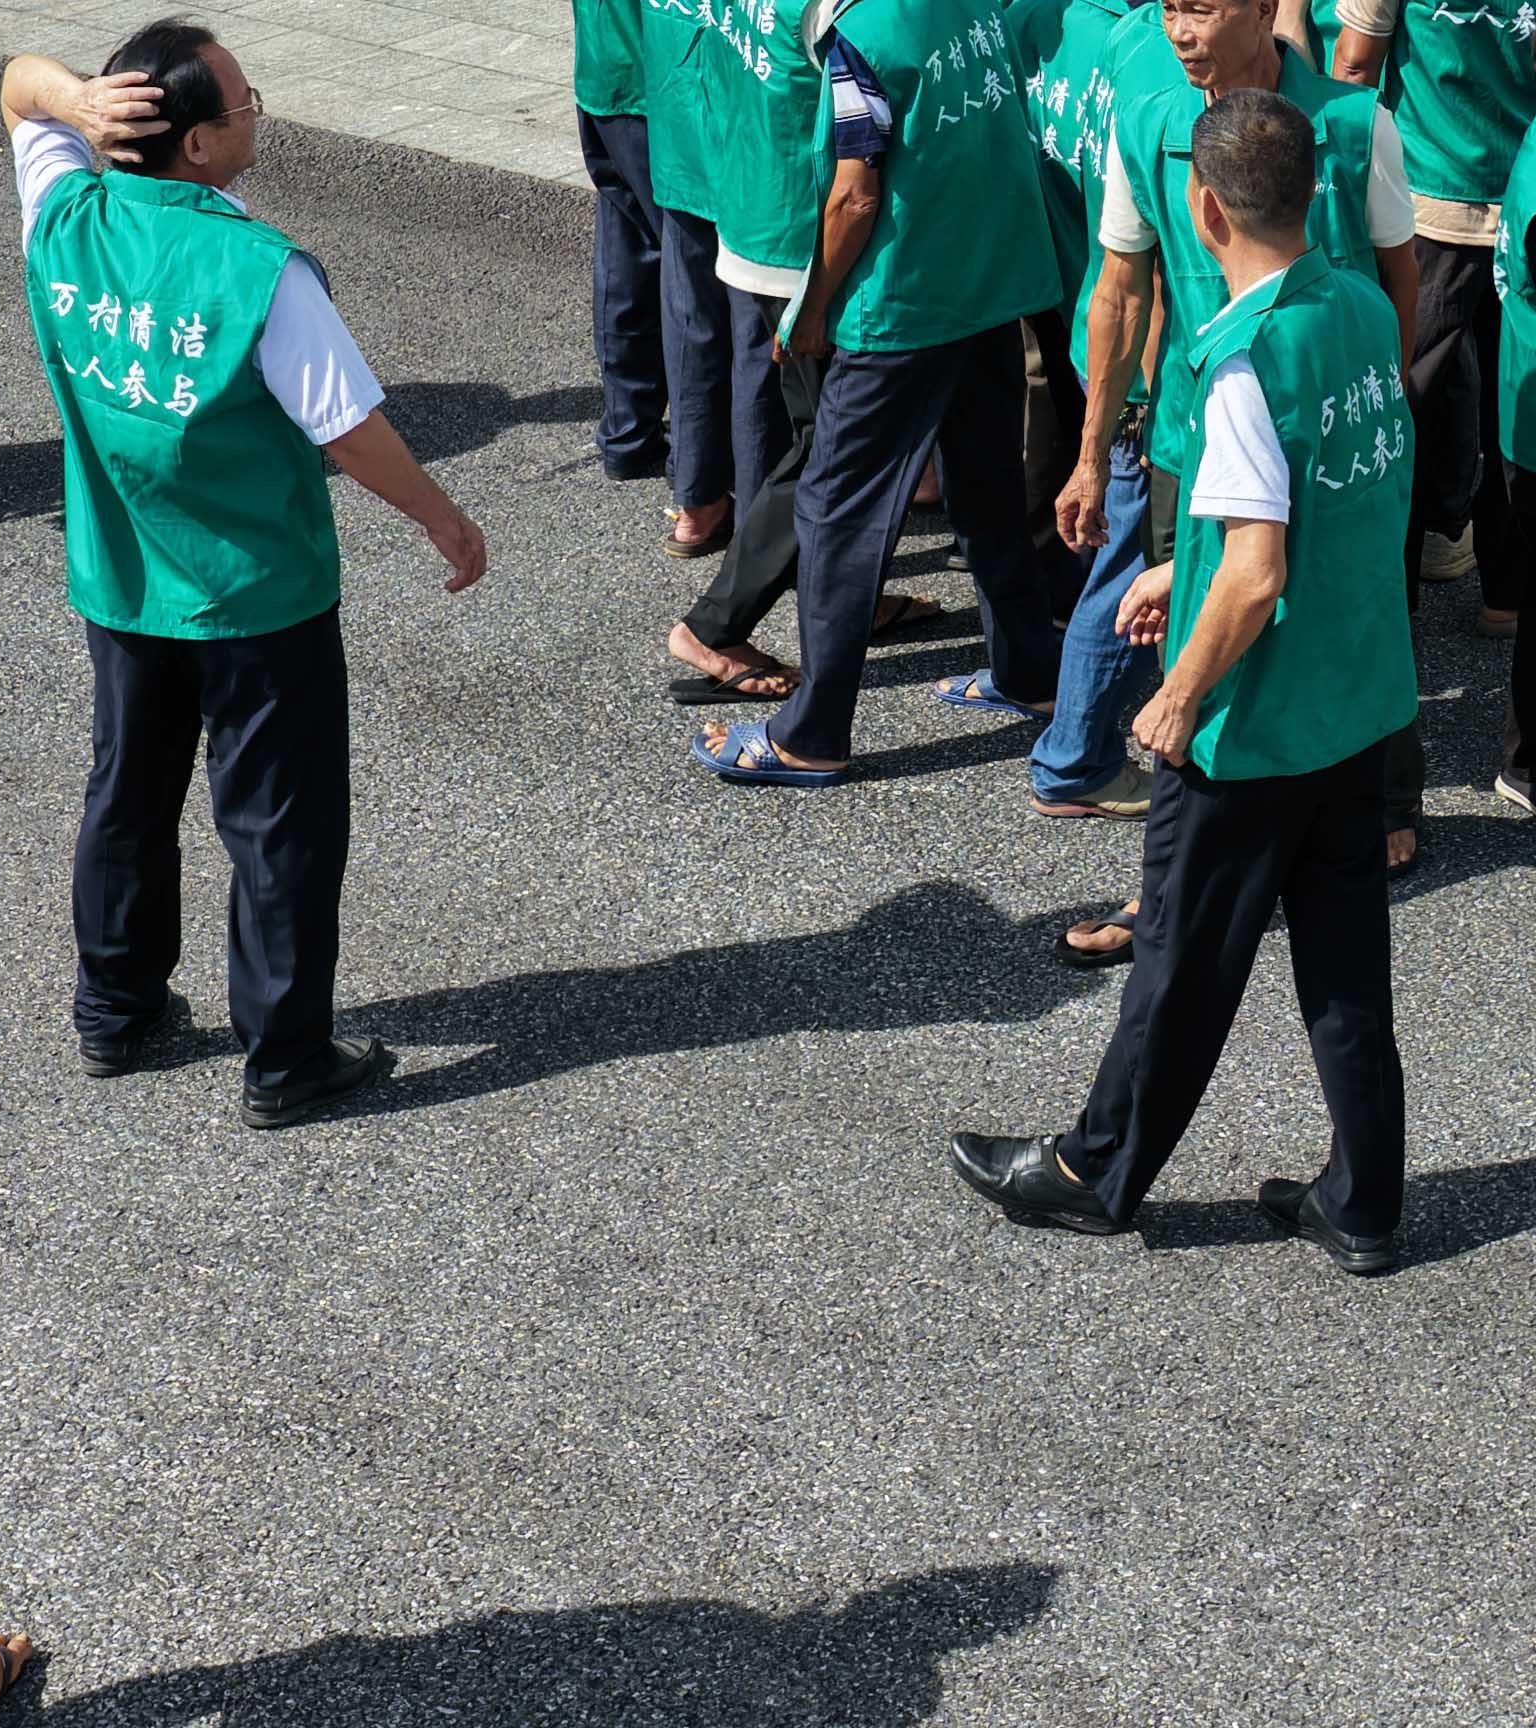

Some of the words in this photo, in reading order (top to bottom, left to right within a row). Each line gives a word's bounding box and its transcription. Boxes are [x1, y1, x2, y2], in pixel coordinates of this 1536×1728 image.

[935, 64, 1016, 132] 人人参
[49, 282, 208, 359] 万村清洁
[1316, 418, 1405, 489] 人人参与
